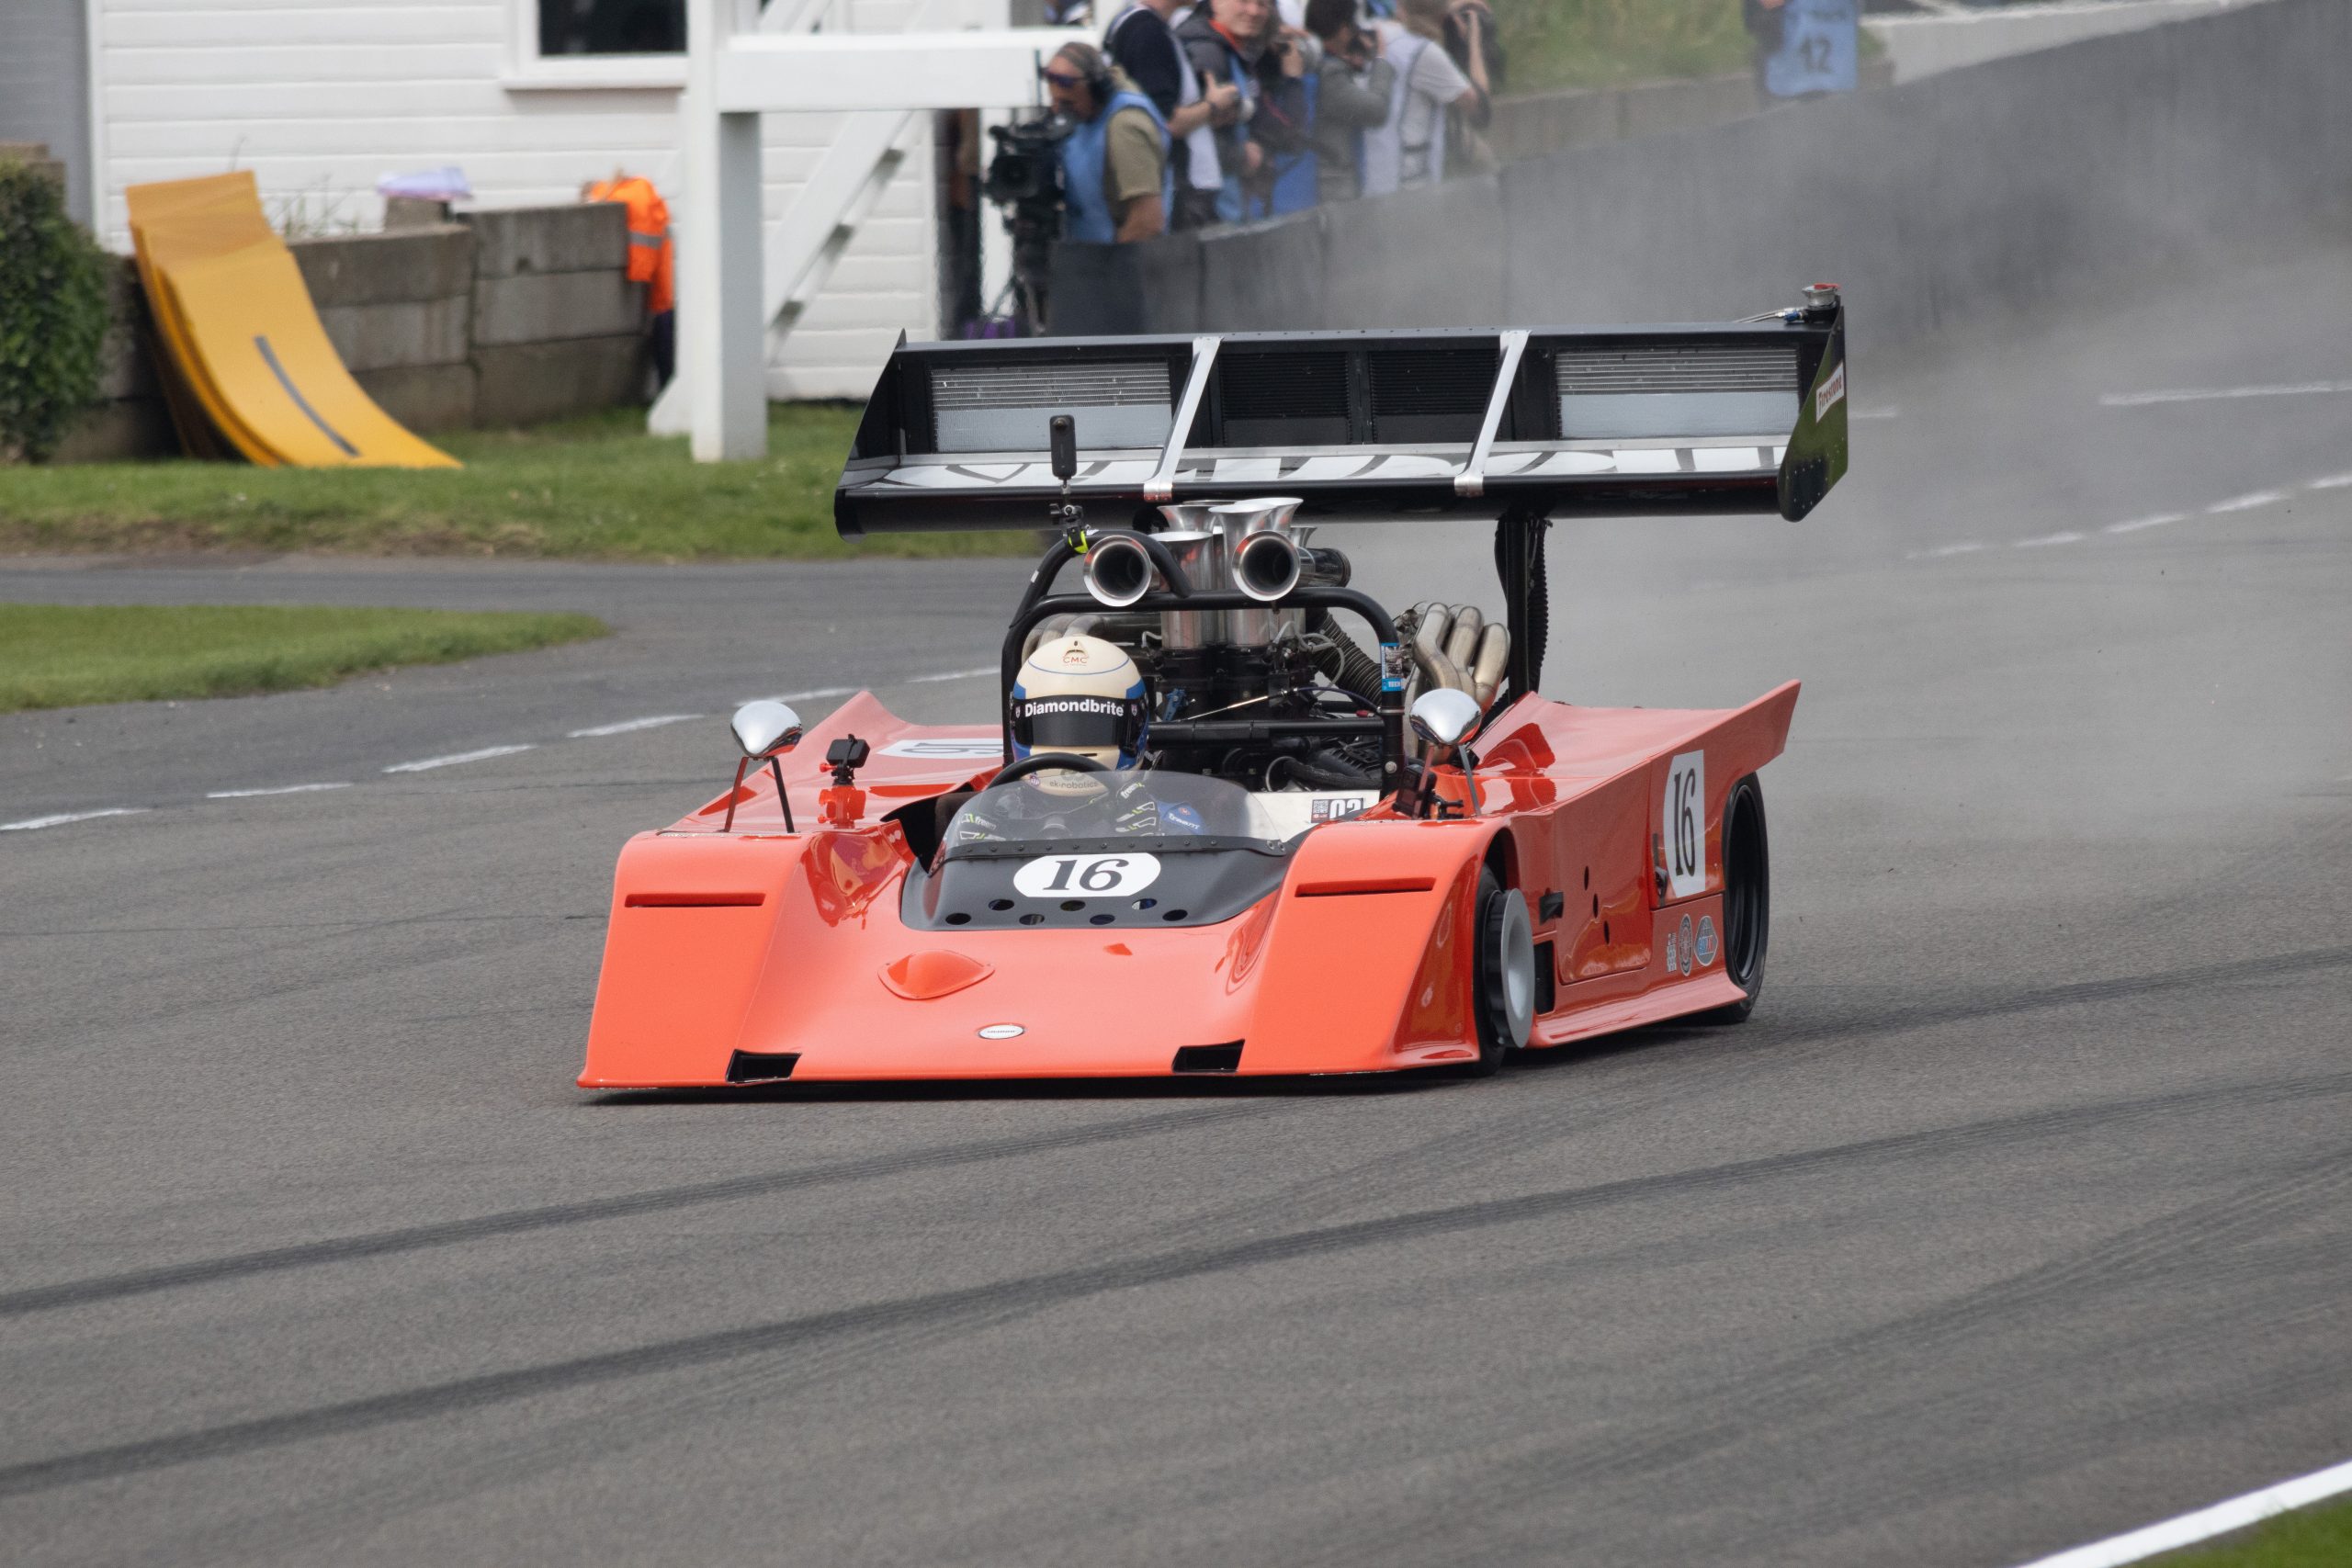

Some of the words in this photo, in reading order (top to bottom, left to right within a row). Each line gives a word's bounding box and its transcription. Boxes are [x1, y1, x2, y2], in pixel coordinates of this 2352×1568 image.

[1024, 699, 1125, 717] Diamondbrite
[1674, 767, 1696, 877] 16
[1043, 858, 1129, 891] 16
